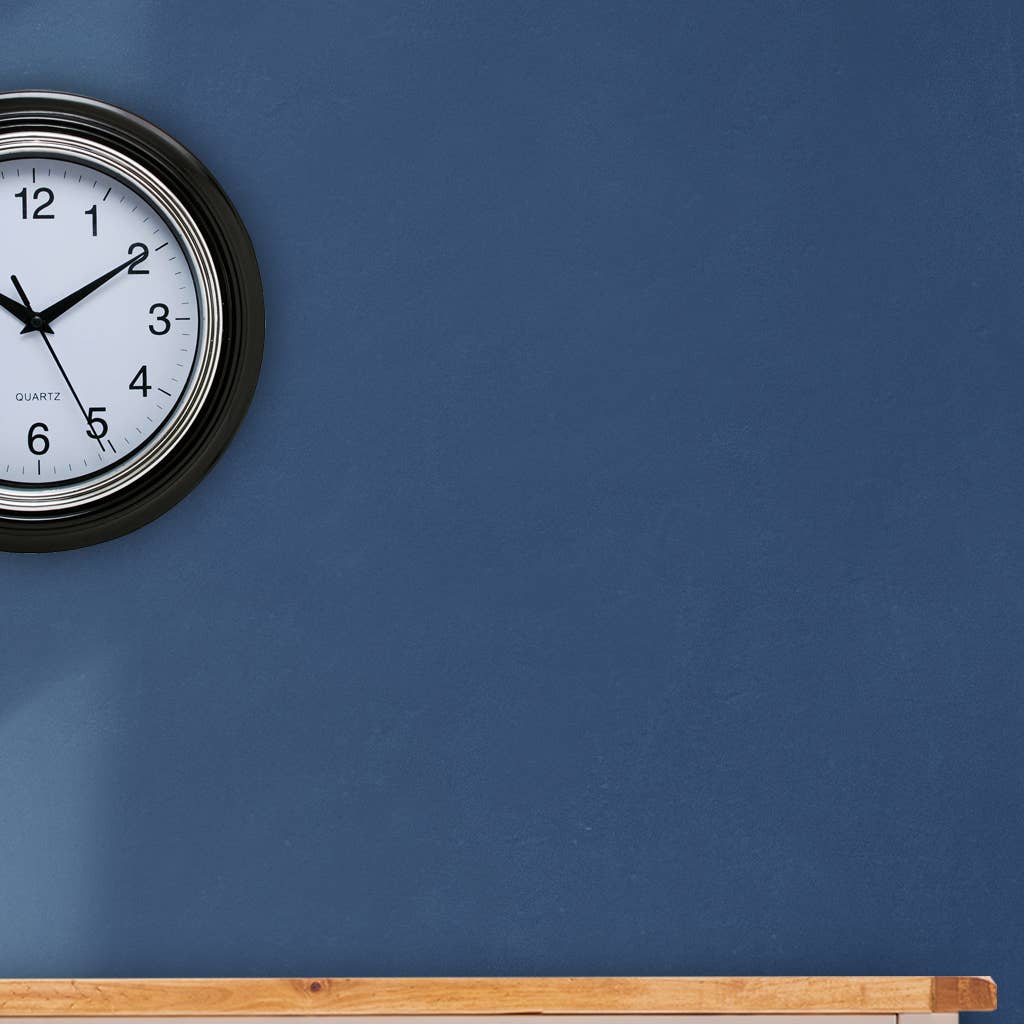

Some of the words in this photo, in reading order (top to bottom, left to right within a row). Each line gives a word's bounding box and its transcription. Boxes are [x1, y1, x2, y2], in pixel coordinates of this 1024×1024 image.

[14, 187, 56, 220] 12
[84, 204, 98, 237] 1
[127, 242, 150, 275] 2
[148, 303, 171, 335] 3
[15, 392, 61, 402] QUARTZ
[128, 365, 152, 397] 4
[27, 422, 50, 455] 6
[85, 407, 108, 439] 5
